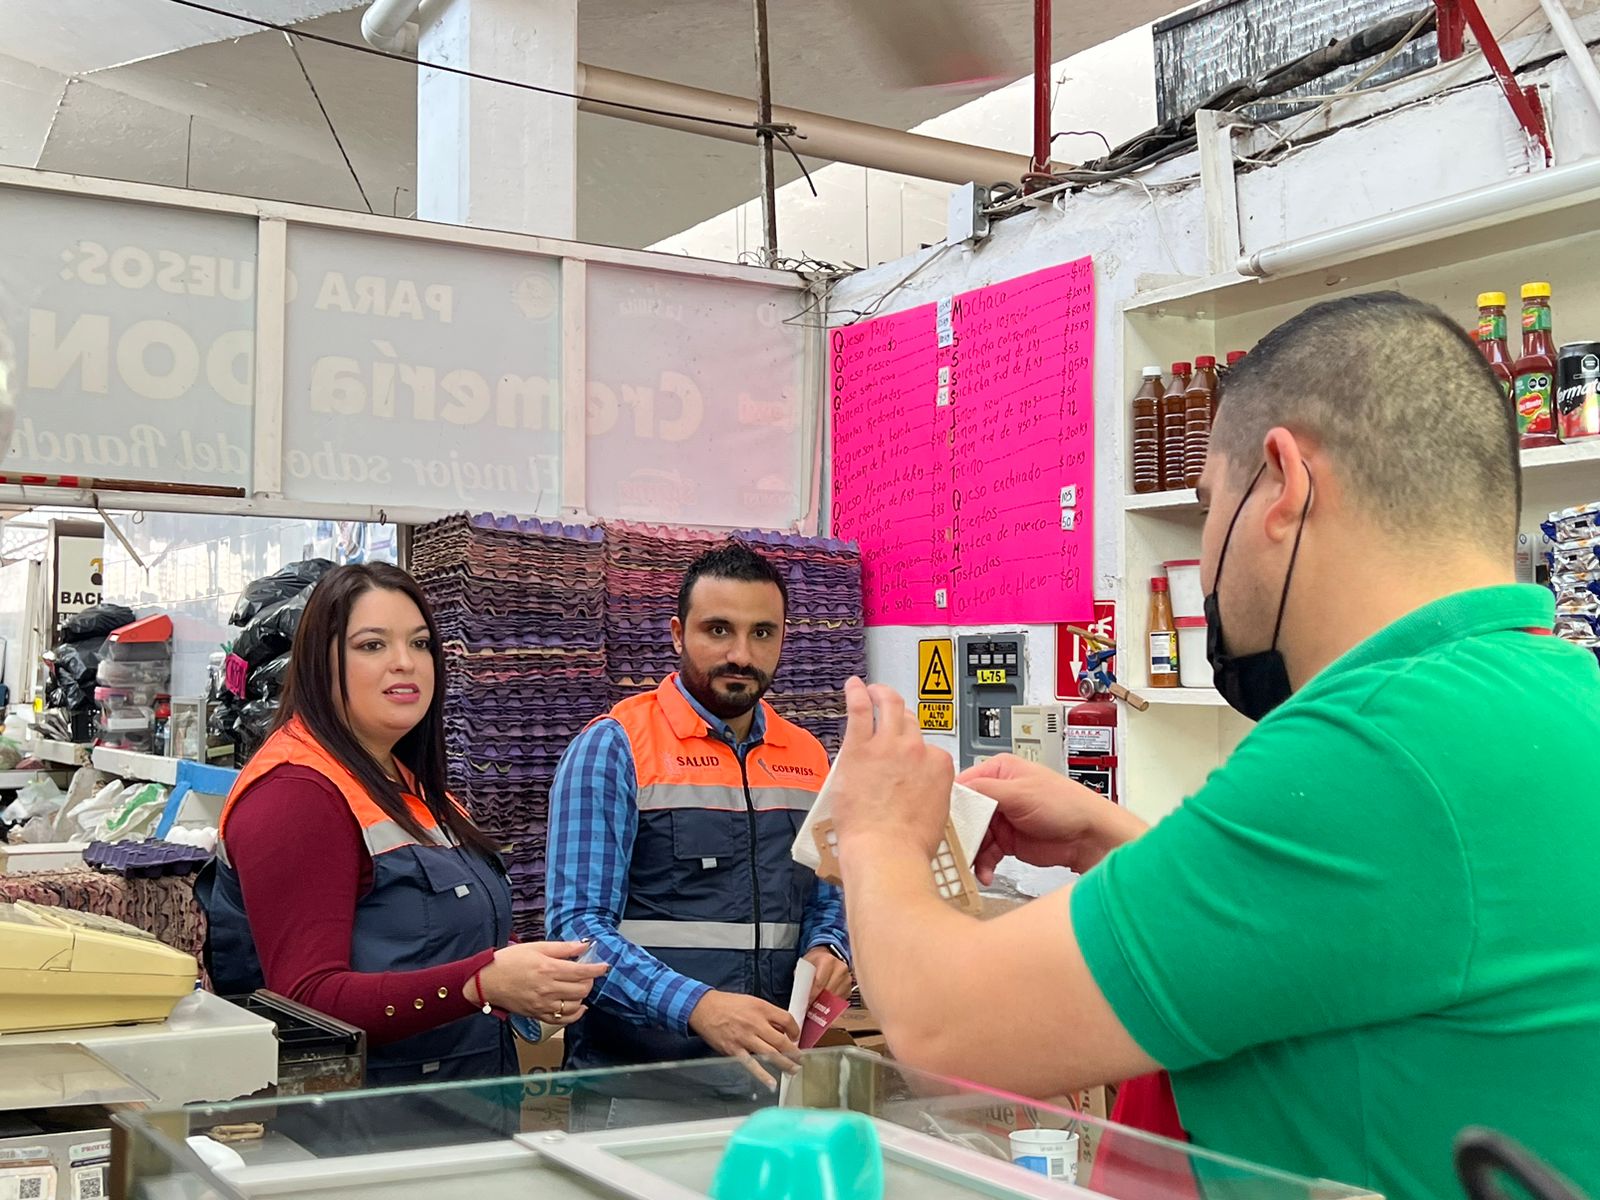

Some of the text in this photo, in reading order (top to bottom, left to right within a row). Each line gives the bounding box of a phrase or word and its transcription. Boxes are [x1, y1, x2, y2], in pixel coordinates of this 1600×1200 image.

[952, 291, 1006, 324] Machaca
[833, 330, 864, 353] Queso
[834, 351, 864, 373] Queso
[835, 370, 863, 392] Queso
[1005, 402, 1014, 418] de
[1000, 424, 1010, 439] de
[833, 495, 861, 520] Queso
[952, 486, 987, 512] Queso
[952, 532, 992, 563] Manteca
[997, 523, 1008, 541] de
[950, 556, 1001, 588] Tostadas
[1000, 575, 1012, 596] de
[1015, 571, 1046, 596] Huevo
[981, 671, 1001, 682] L-75
[923, 719, 949, 728] VOLTAJE
[929, 711, 944, 719] ALTO
[676, 756, 719, 767] SALUD
